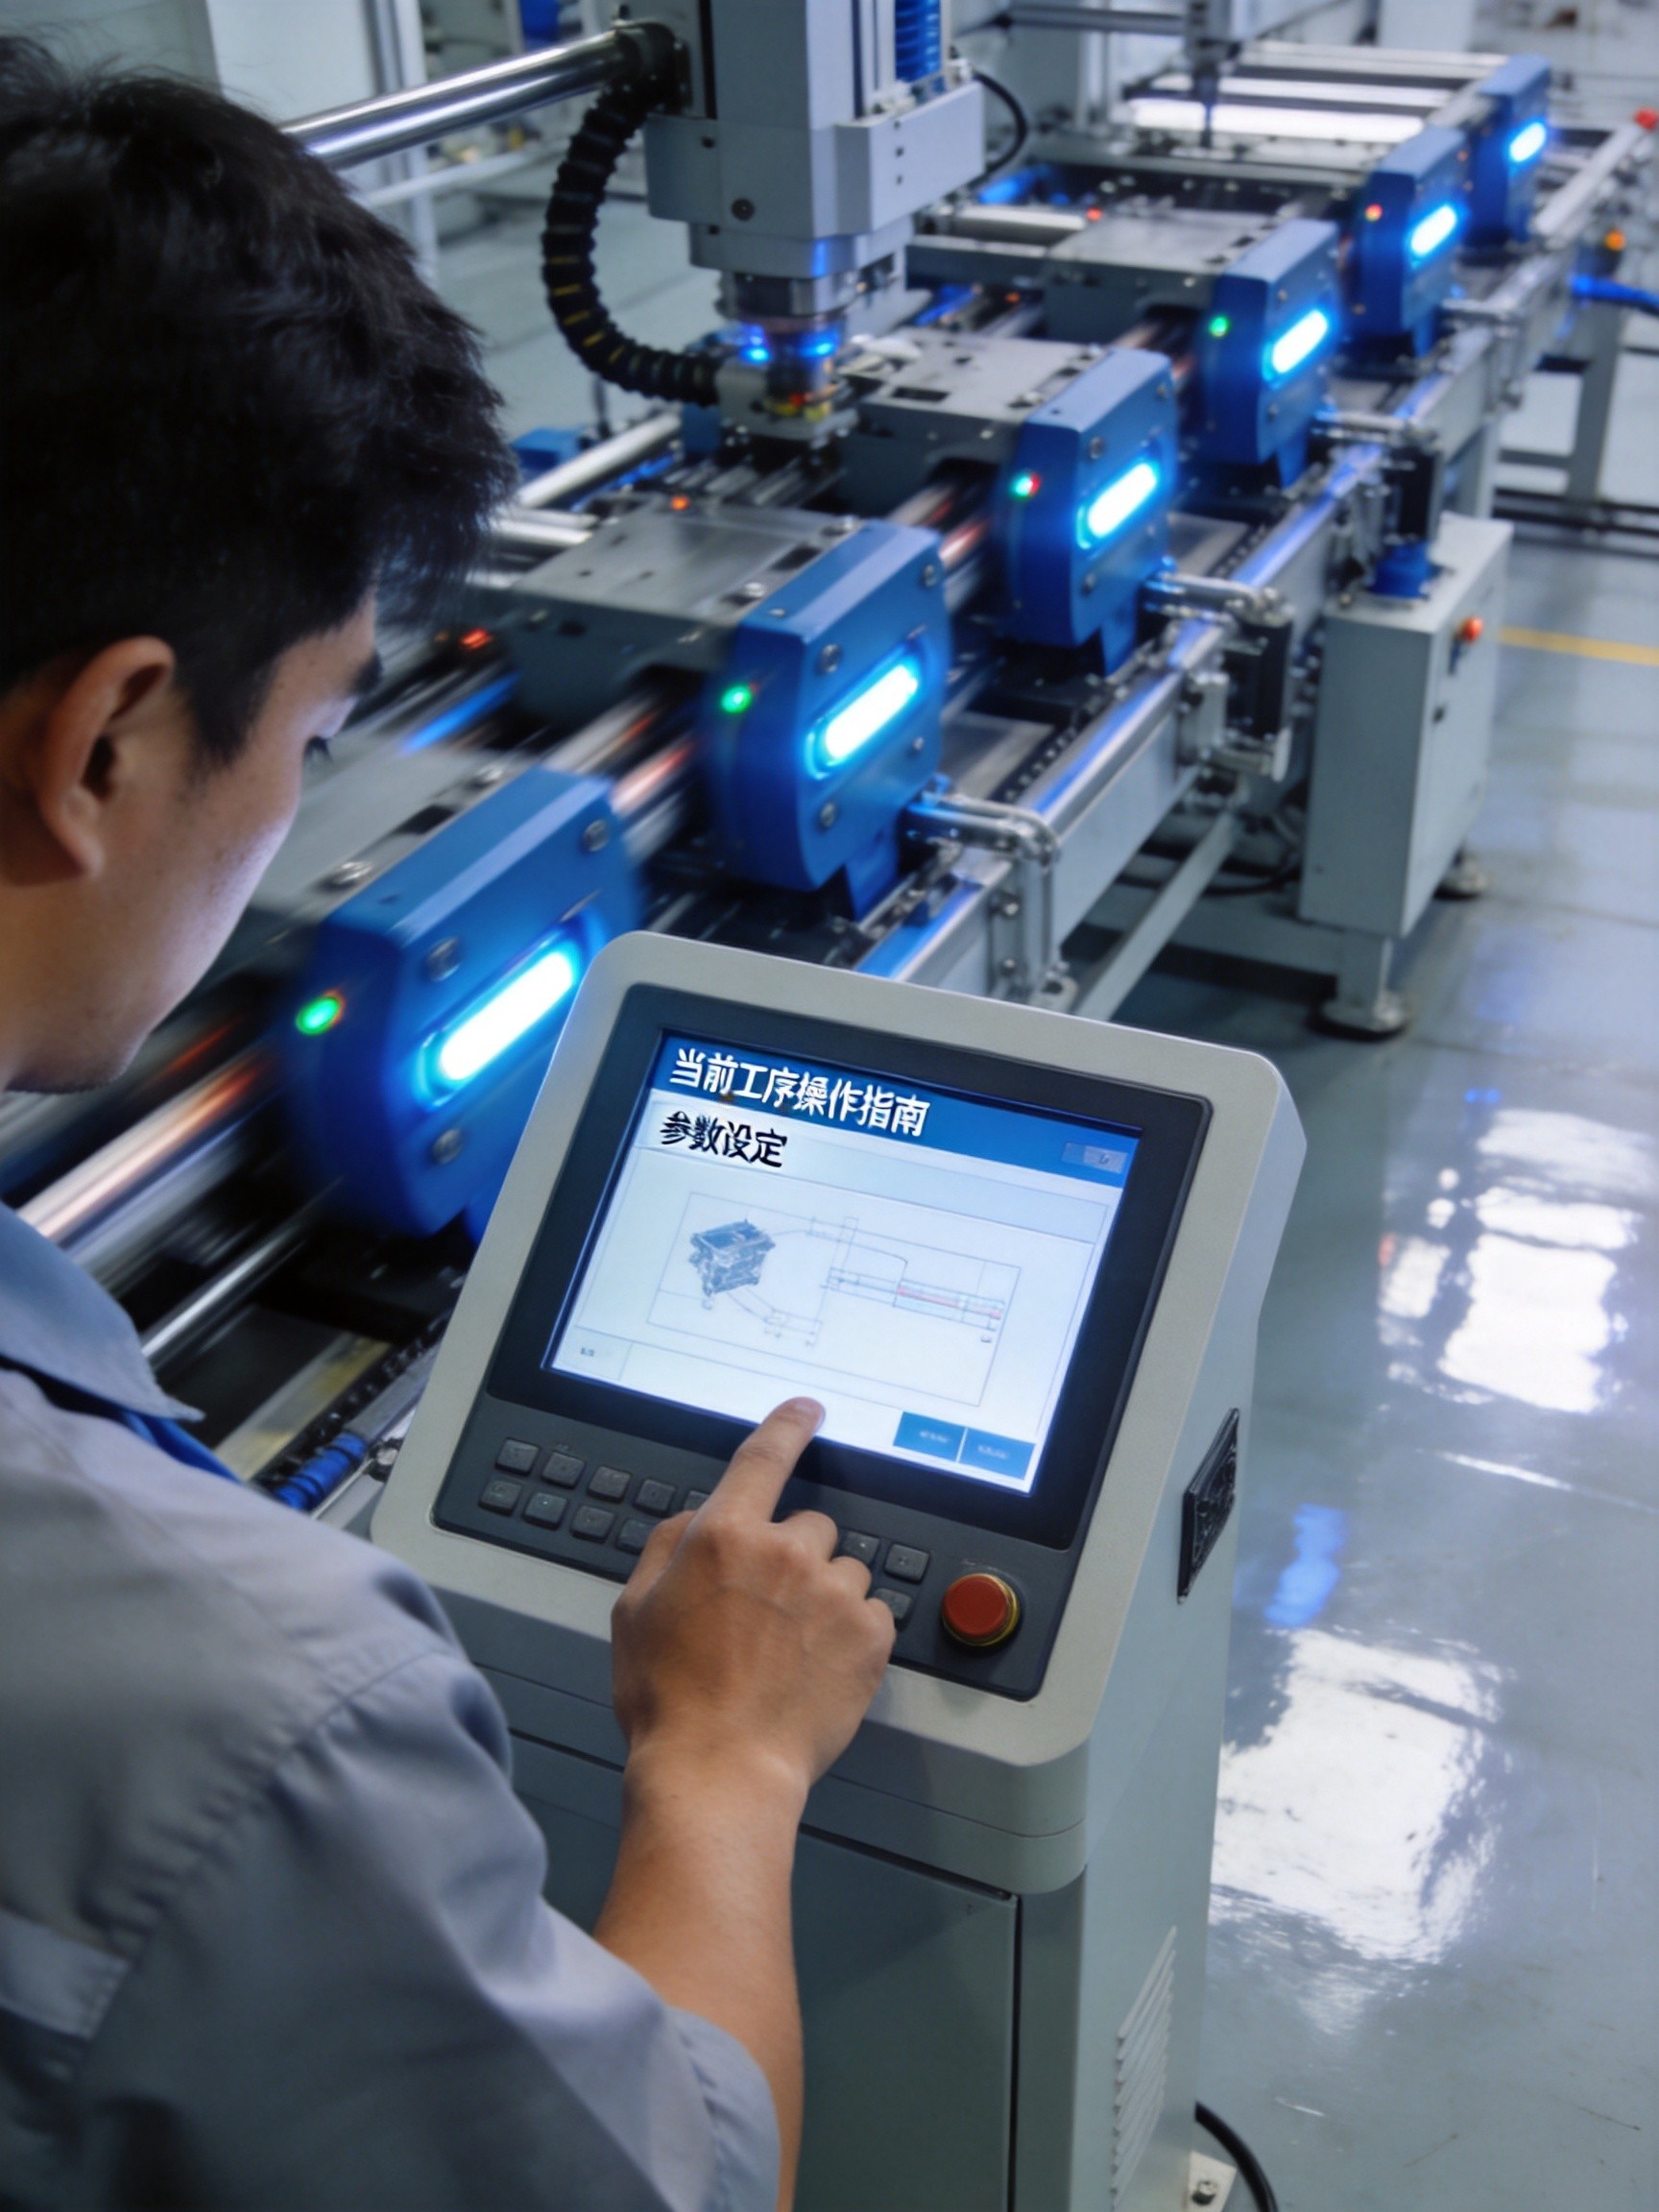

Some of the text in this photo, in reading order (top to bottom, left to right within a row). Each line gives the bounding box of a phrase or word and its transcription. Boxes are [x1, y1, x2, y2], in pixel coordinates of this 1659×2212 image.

[669, 1047, 930, 1137] 当前工序操作指南
[660, 1110, 787, 1168] 参数设定
